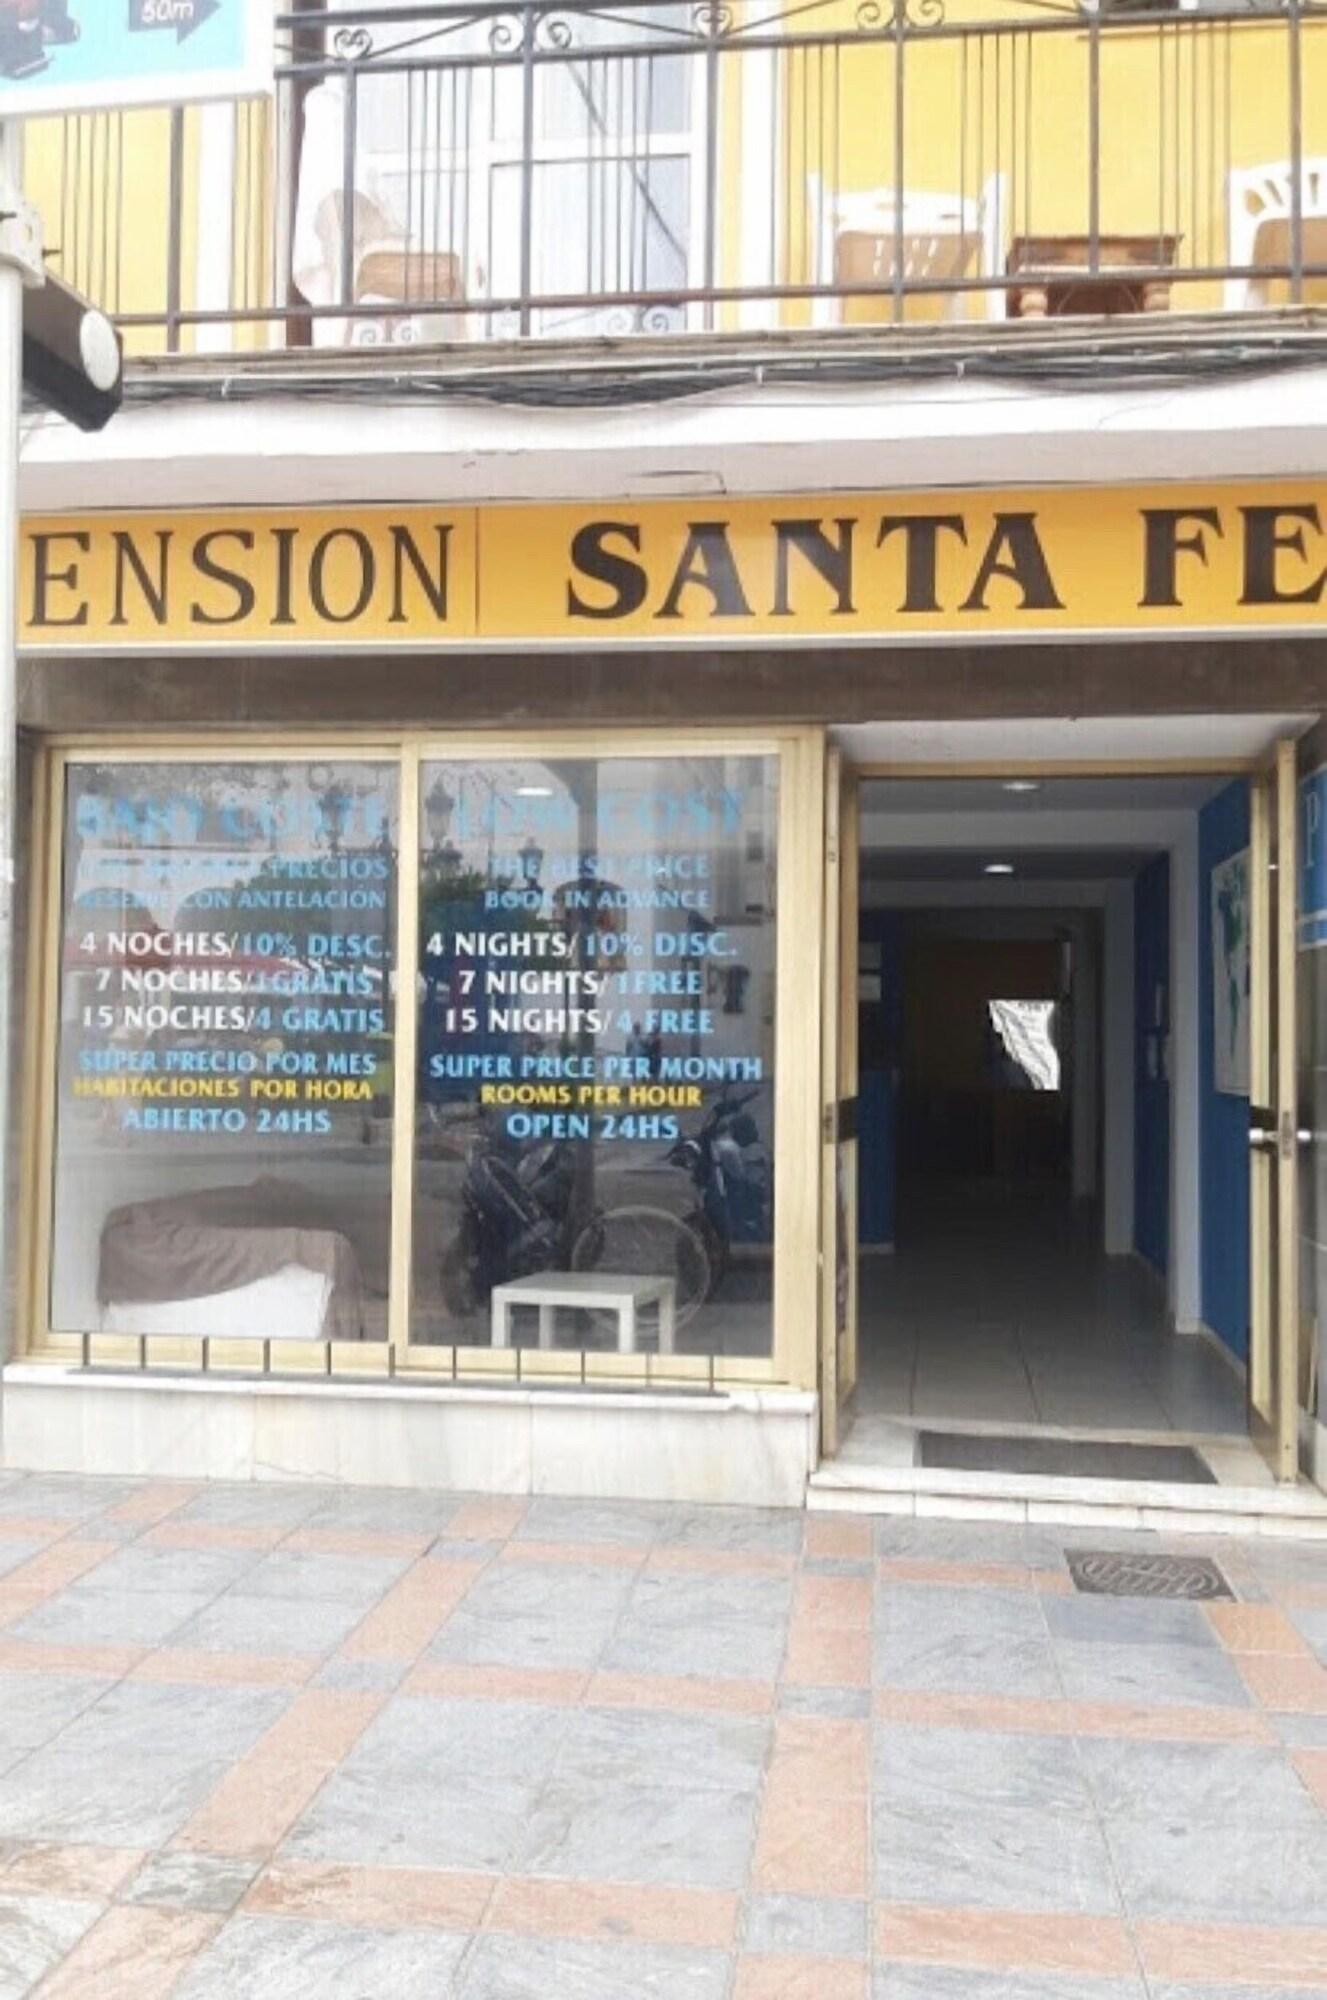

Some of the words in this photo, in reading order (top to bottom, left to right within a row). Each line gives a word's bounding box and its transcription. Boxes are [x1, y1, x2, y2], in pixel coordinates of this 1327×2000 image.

[567, 512, 1066, 619] SANTA
[1137, 504, 1327, 608] FE
[271, 856, 388, 880] PRECIOS
[489, 855, 539, 878] THE
[485, 889, 553, 909] BOOK
[564, 889, 590, 908] IN
[598, 889, 710, 909] ADVANCE
[80, 932, 98, 951] 4
[307, 934, 391, 957] DESC.
[426, 932, 444, 956] 4
[655, 933, 737, 957] DISC.
[95, 968, 112, 991] 7
[458, 970, 476, 995] 7
[83, 1006, 113, 1027] 15
[282, 1007, 385, 1033] GRATIS
[445, 1009, 478, 1032] 15
[644, 1010, 715, 1034] FREE
[79, 1051, 156, 1073] SUPER
[166, 1051, 257, 1074] PRECIO
[266, 1051, 319, 1075] POR
[326, 1053, 377, 1075] MES
[430, 1054, 513, 1078] SUPER
[520, 1055, 595, 1079] PRICE
[603, 1056, 651, 1080] PER
[659, 1057, 763, 1081] MONTH
[72, 1076, 241, 1098] HABITACIONES
[250, 1078, 298, 1099] POR
[305, 1079, 374, 1100] HORA
[481, 1085, 571, 1105] ROOMS
[579, 1086, 622, 1106] PER
[629, 1086, 702, 1107] HOUR
[122, 1108, 246, 1133] ABIERTO
[256, 1109, 332, 1134] 24HS
[506, 1114, 590, 1138] OPEN
[602, 1115, 679, 1139] 24HS
